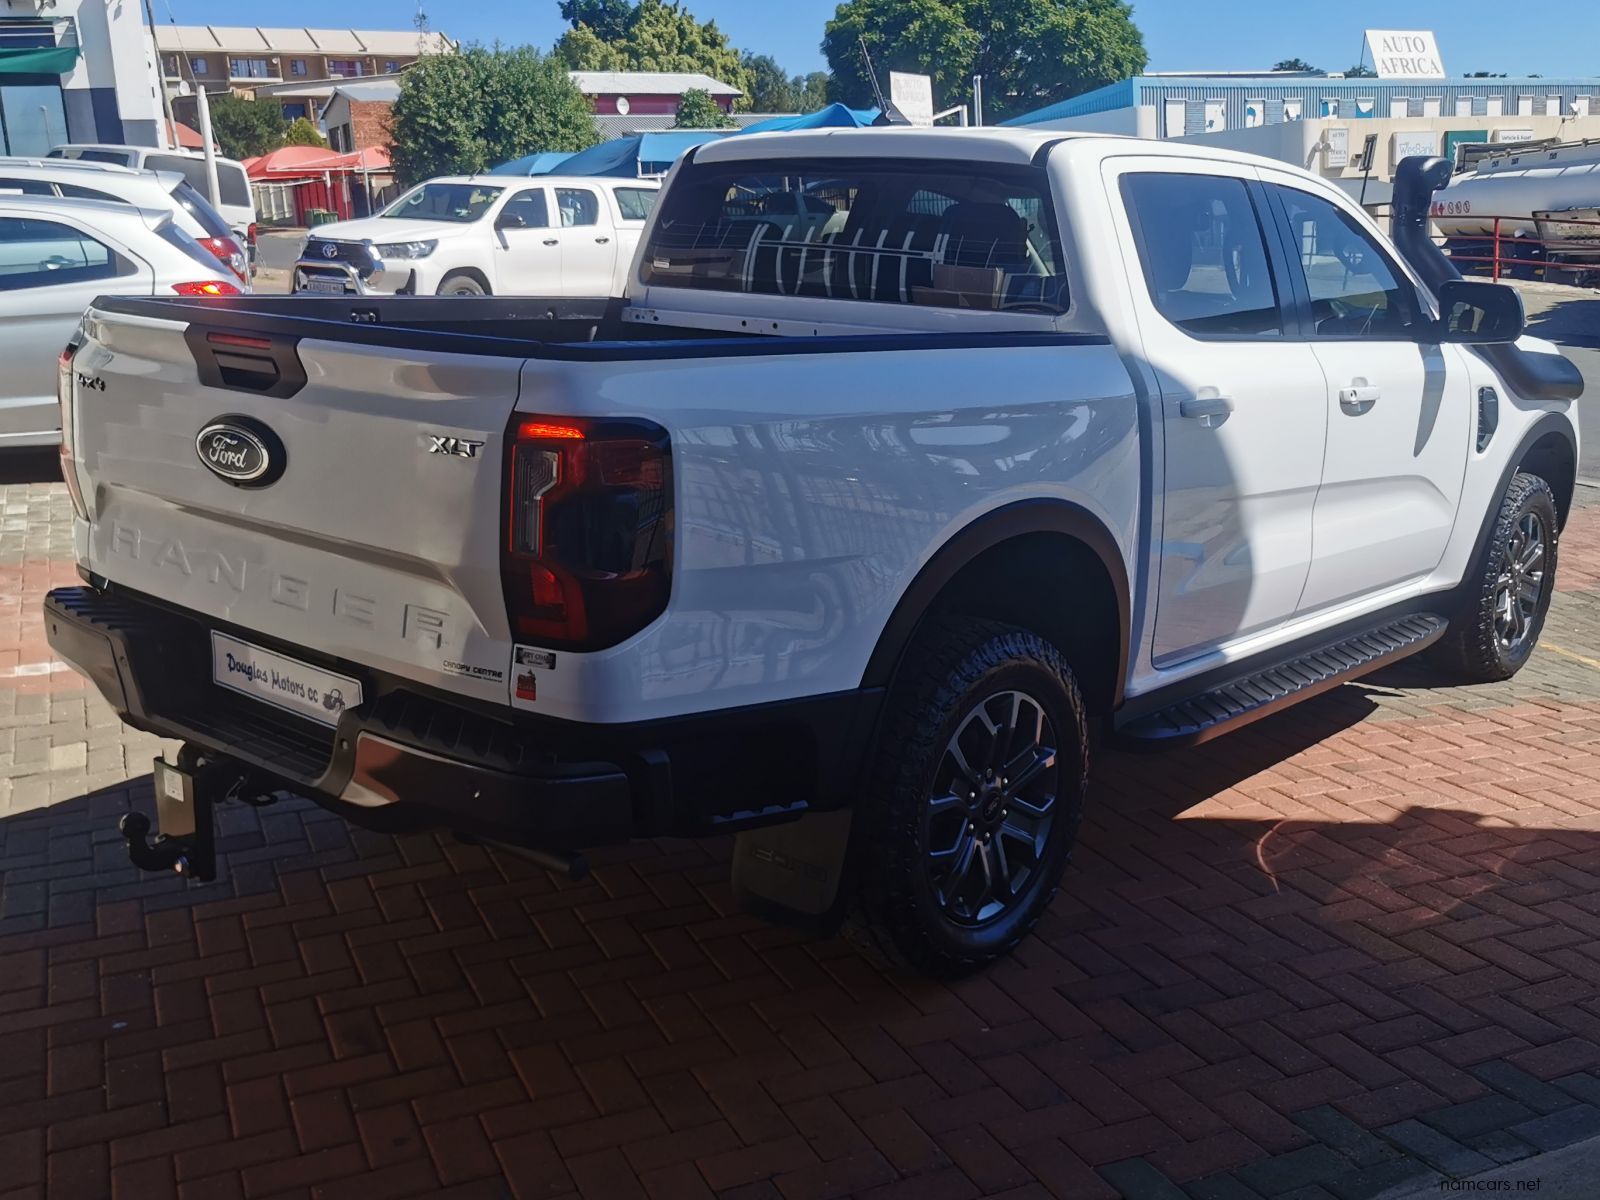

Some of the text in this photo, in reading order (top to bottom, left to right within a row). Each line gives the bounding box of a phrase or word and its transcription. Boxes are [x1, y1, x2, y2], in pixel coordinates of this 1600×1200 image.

[1382, 35, 1426, 54] AUTO
[1380, 57, 1441, 75] AFRICA
[1399, 141, 1435, 155] WesBank
[209, 434, 248, 468] Ford
[428, 434, 485, 458] XLT
[110, 518, 451, 650] RANGER
[226, 652, 319, 703] Douglas Motors cc
[442, 659, 471, 673] CANOPY
[472, 666, 503, 679] CENTRE
